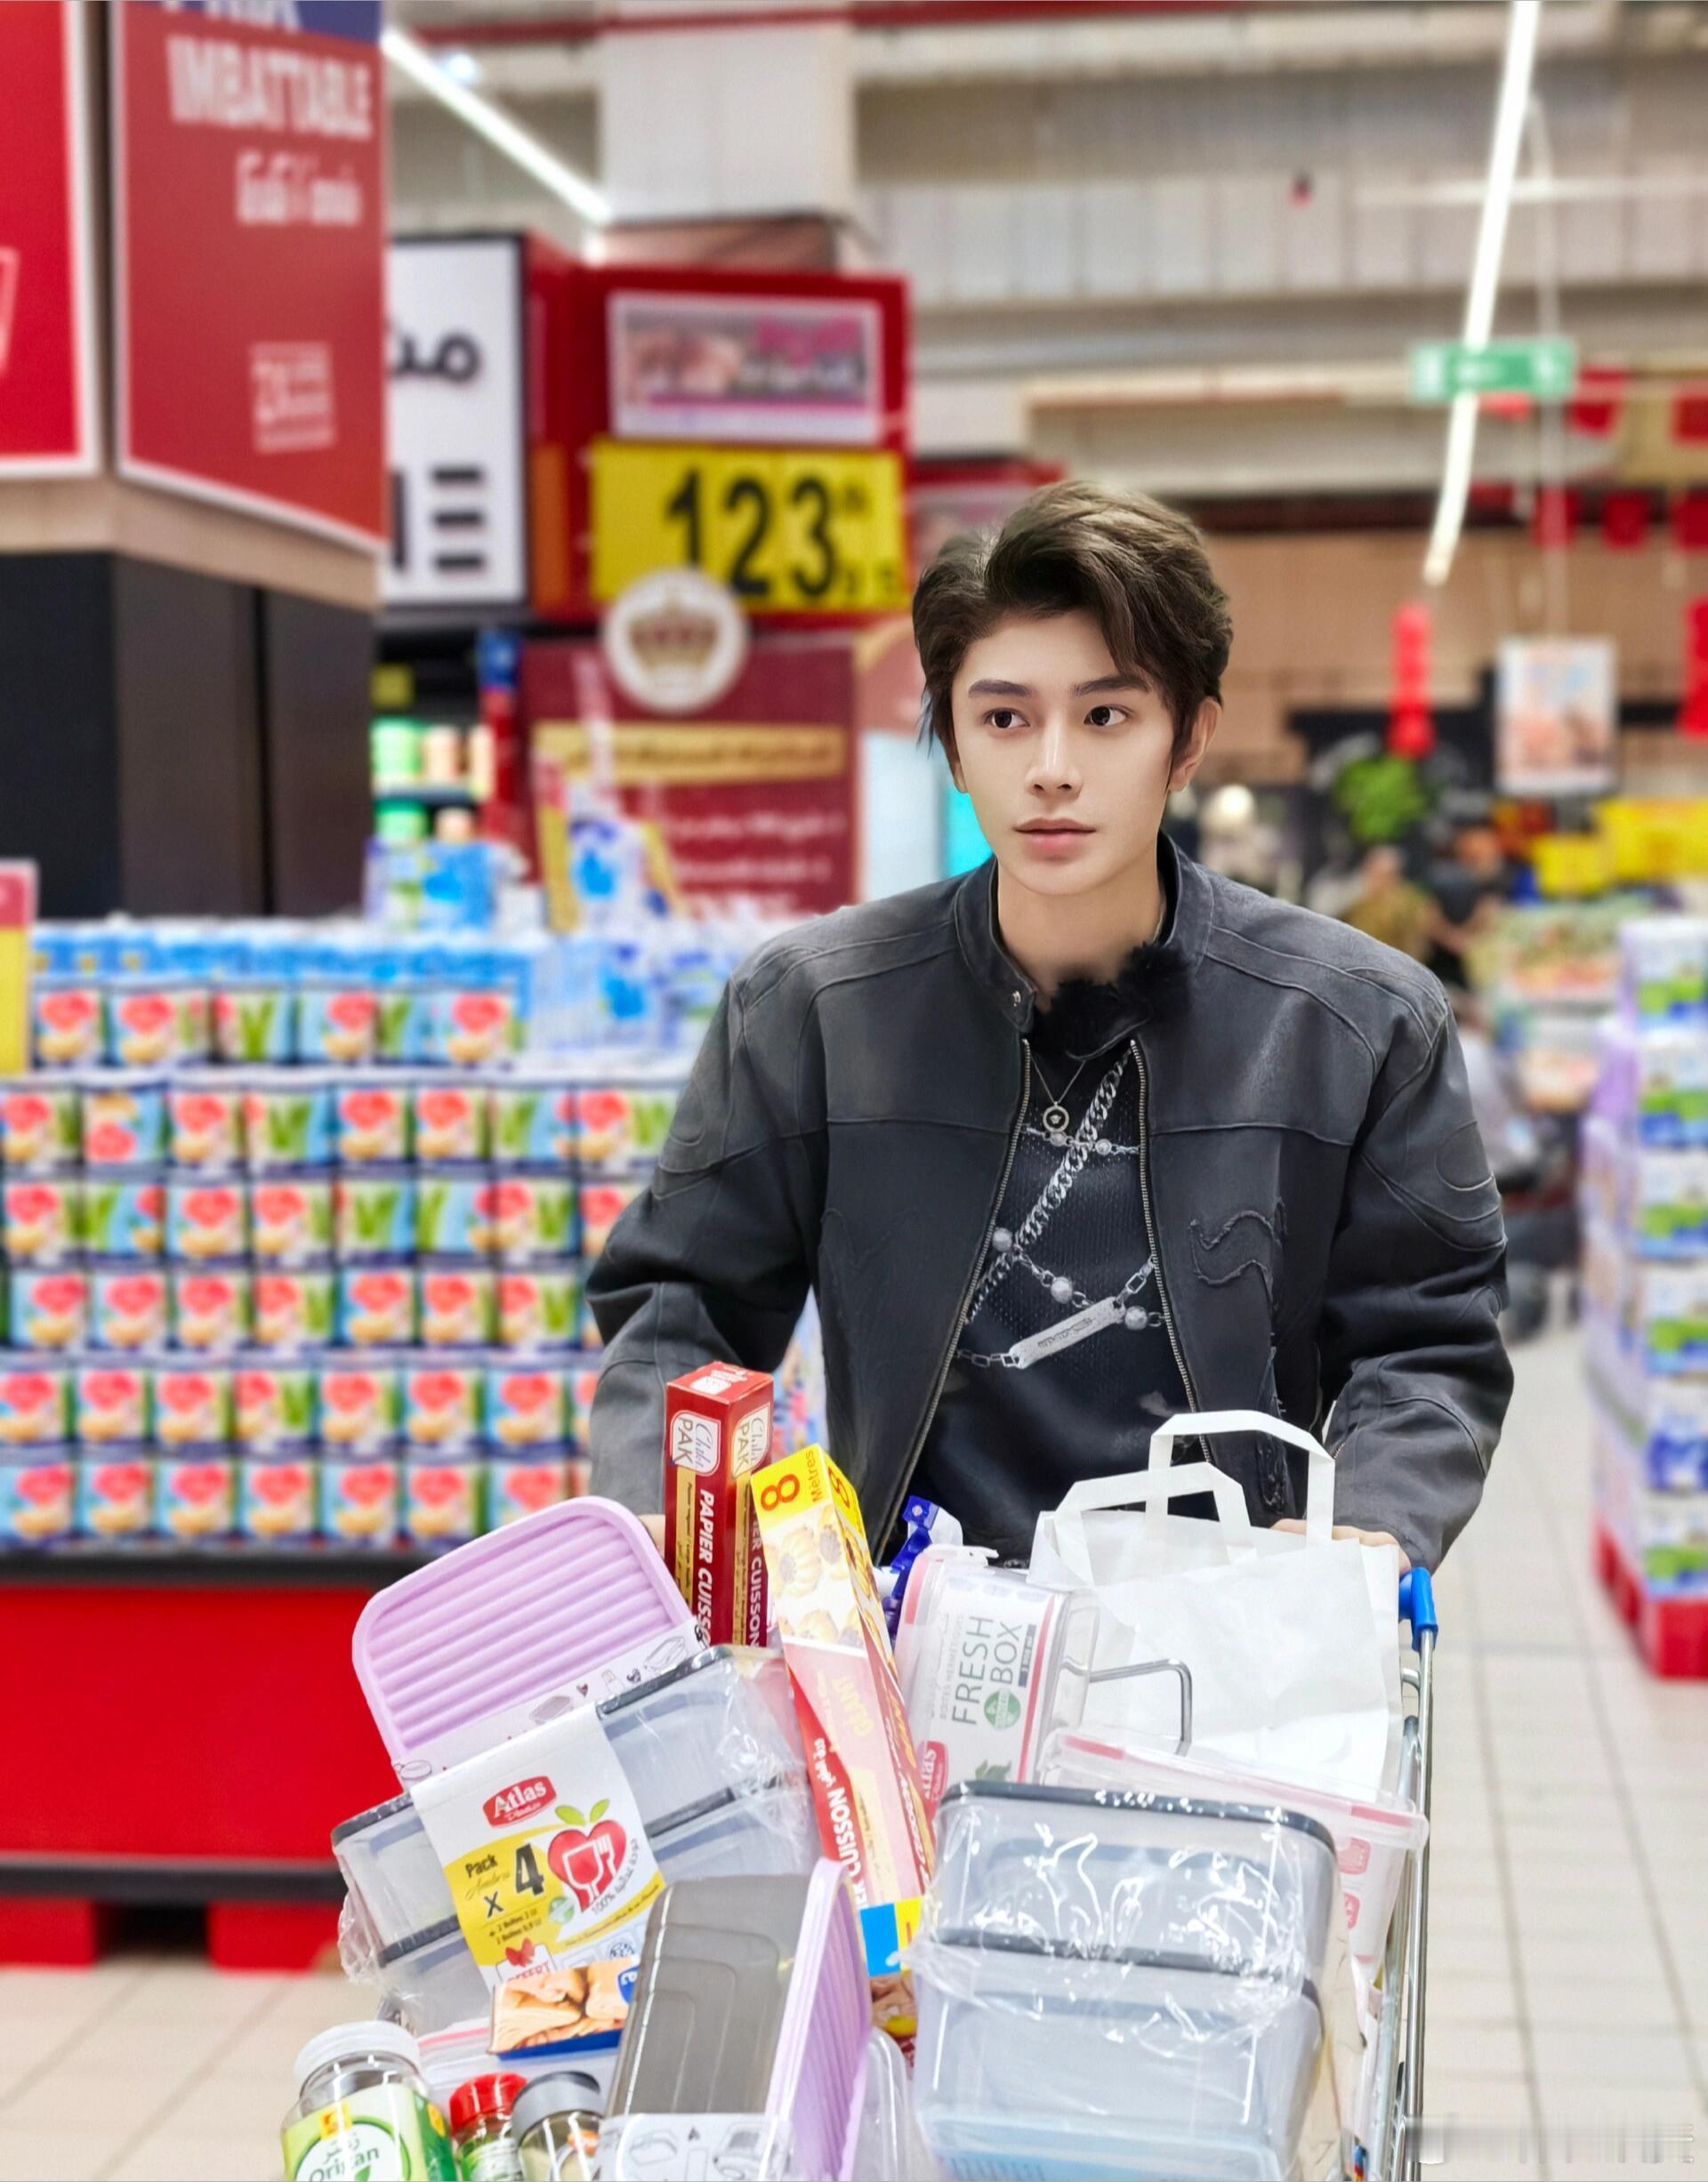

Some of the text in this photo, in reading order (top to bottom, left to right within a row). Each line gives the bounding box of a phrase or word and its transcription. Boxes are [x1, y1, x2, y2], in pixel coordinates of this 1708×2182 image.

[166, 36, 373, 141] IMBATTABLE
[675, 1416, 693, 1464] PAK
[735, 1421, 749, 1476] PAK
[761, 1474, 800, 1510] 8
[699, 1489, 714, 1563] PAPIER
[749, 1558, 762, 1646] CUISSON
[952, 1615, 995, 1725] FRESH
[990, 1622, 1022, 1685] BOX
[495, 1781, 547, 1818] Atlas
[920, 1749, 937, 1800] tlas
[827, 1787, 861, 1878] CUISSON
[465, 1854, 498, 1878] Pack
[516, 1843, 544, 1896] 4
[508, 1961, 551, 1982] FFERT
[309, 2147, 380, 2182] Orian
